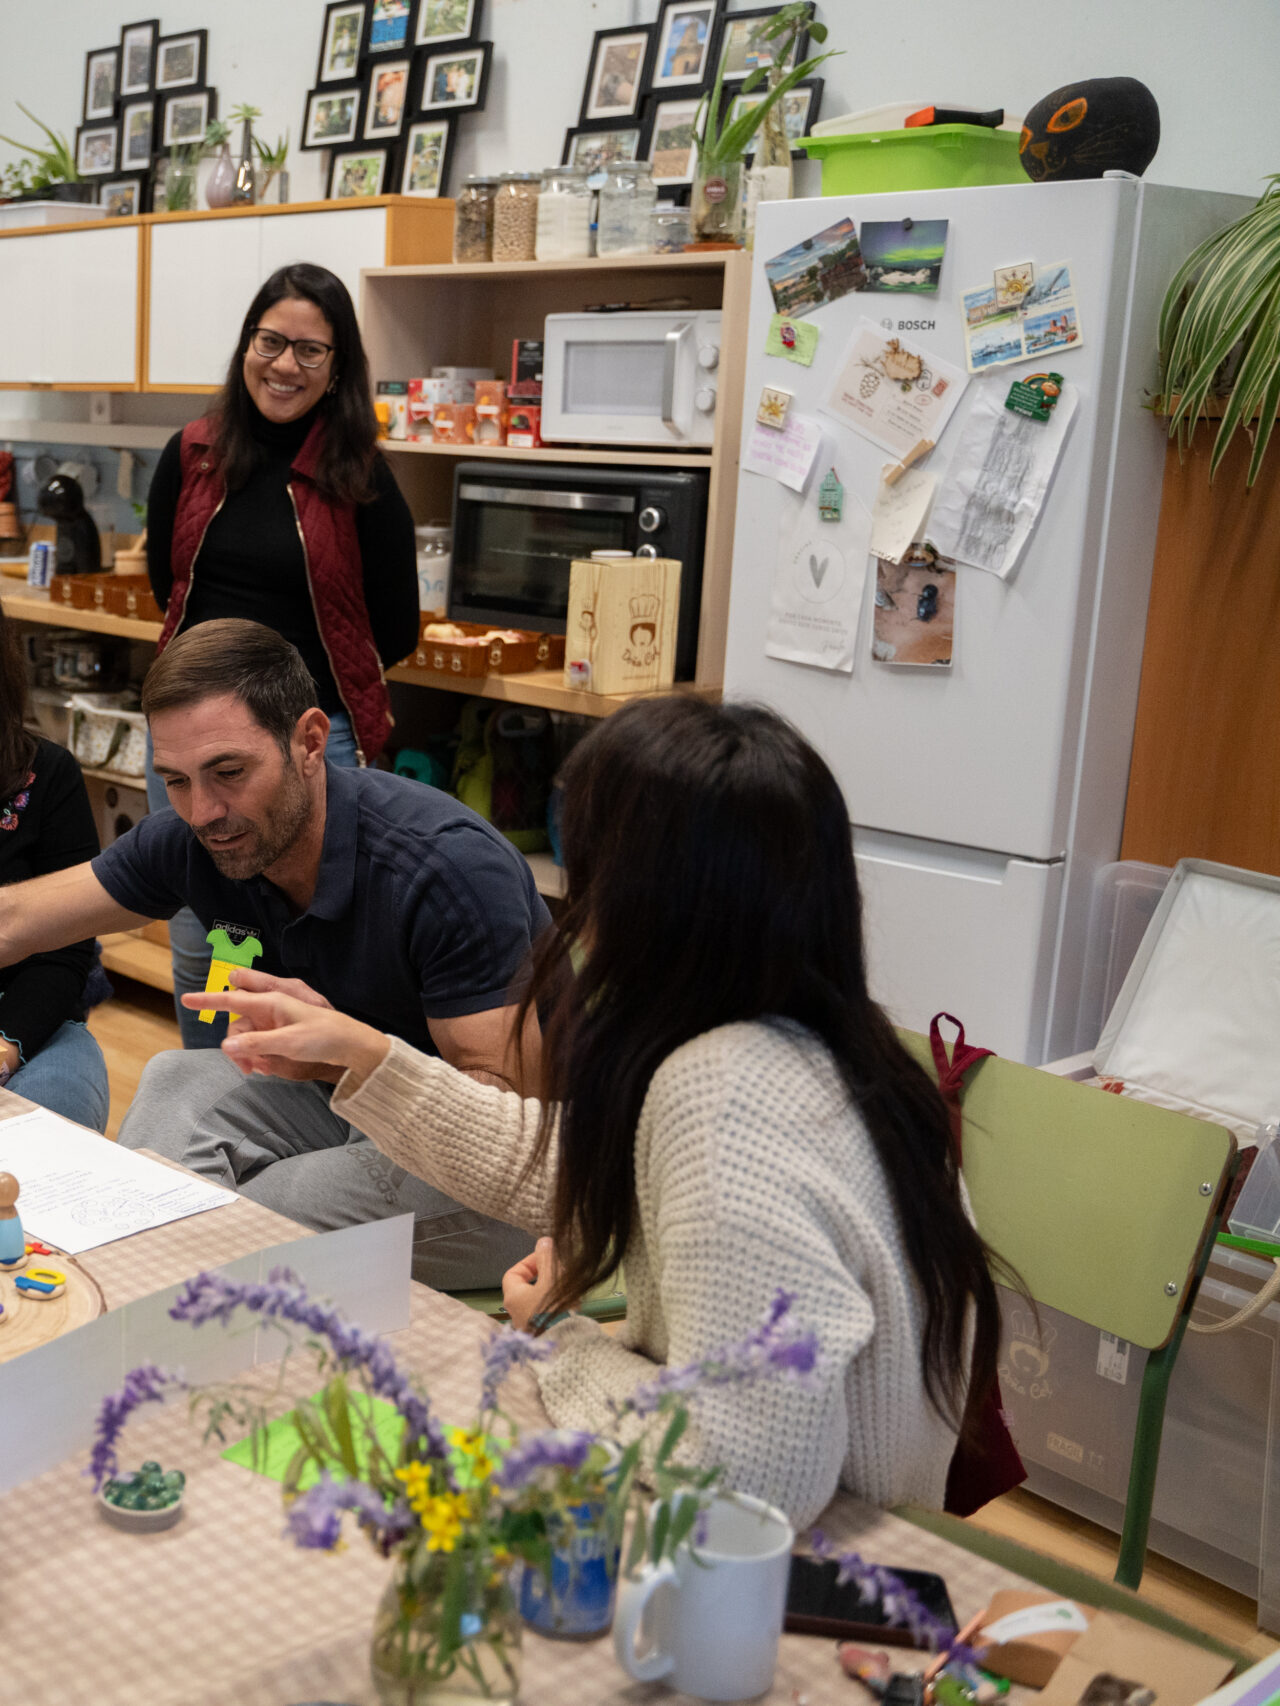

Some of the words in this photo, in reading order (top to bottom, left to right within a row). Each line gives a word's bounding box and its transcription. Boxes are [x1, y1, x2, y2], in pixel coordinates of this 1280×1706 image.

[898, 320, 936, 330] BOSCH
[215, 923, 246, 936] adidas
[14, 1268, 66, 1294] 10
